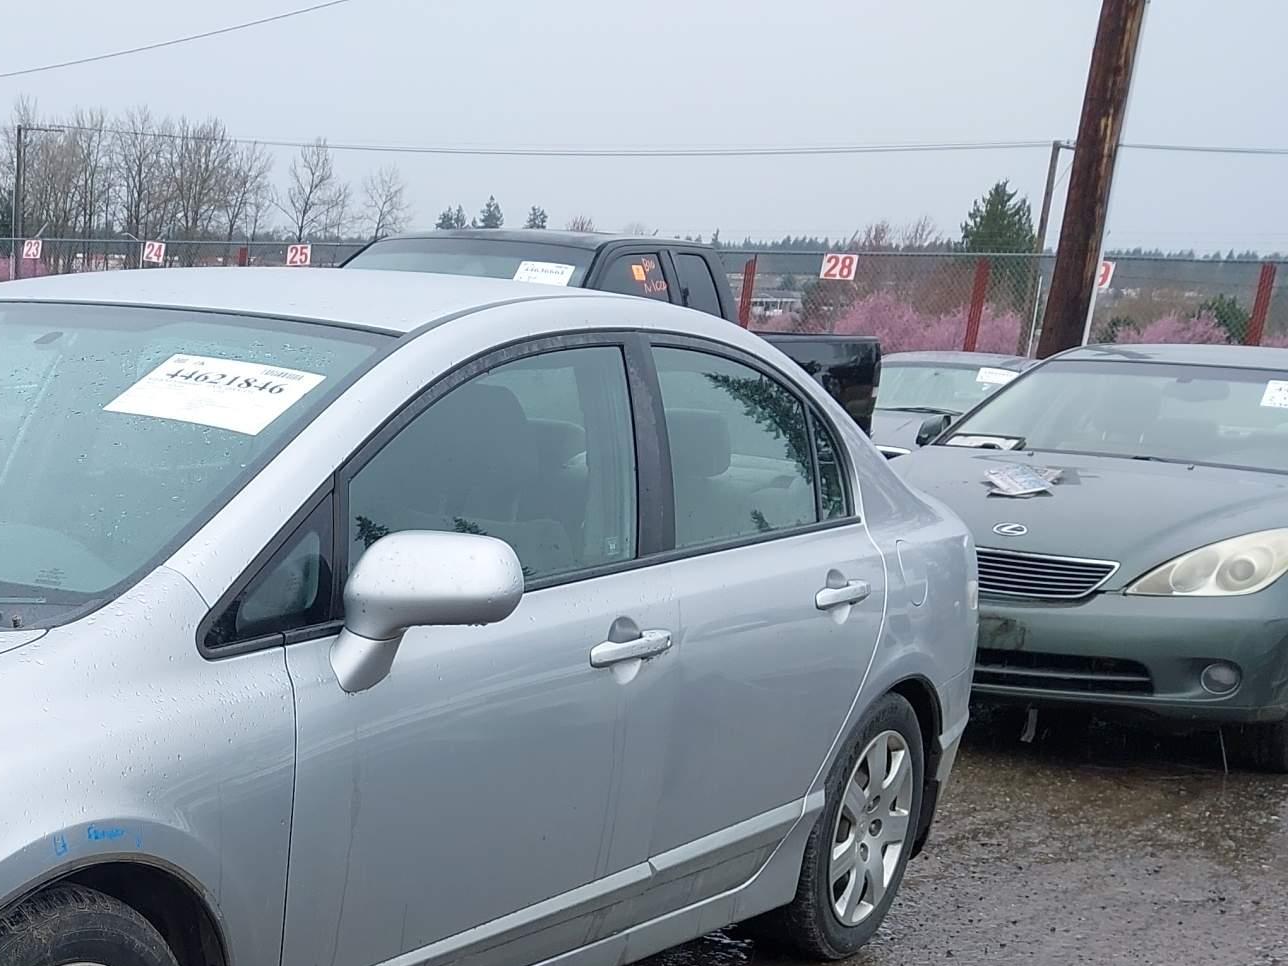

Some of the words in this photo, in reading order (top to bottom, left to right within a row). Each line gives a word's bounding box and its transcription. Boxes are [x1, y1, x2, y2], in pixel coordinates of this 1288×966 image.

[25, 241, 40, 258] 23
[145, 243, 162, 261] 24
[289, 245, 309, 264] 25
[823, 255, 854, 278] 28
[166, 368, 288, 394] 44621846
